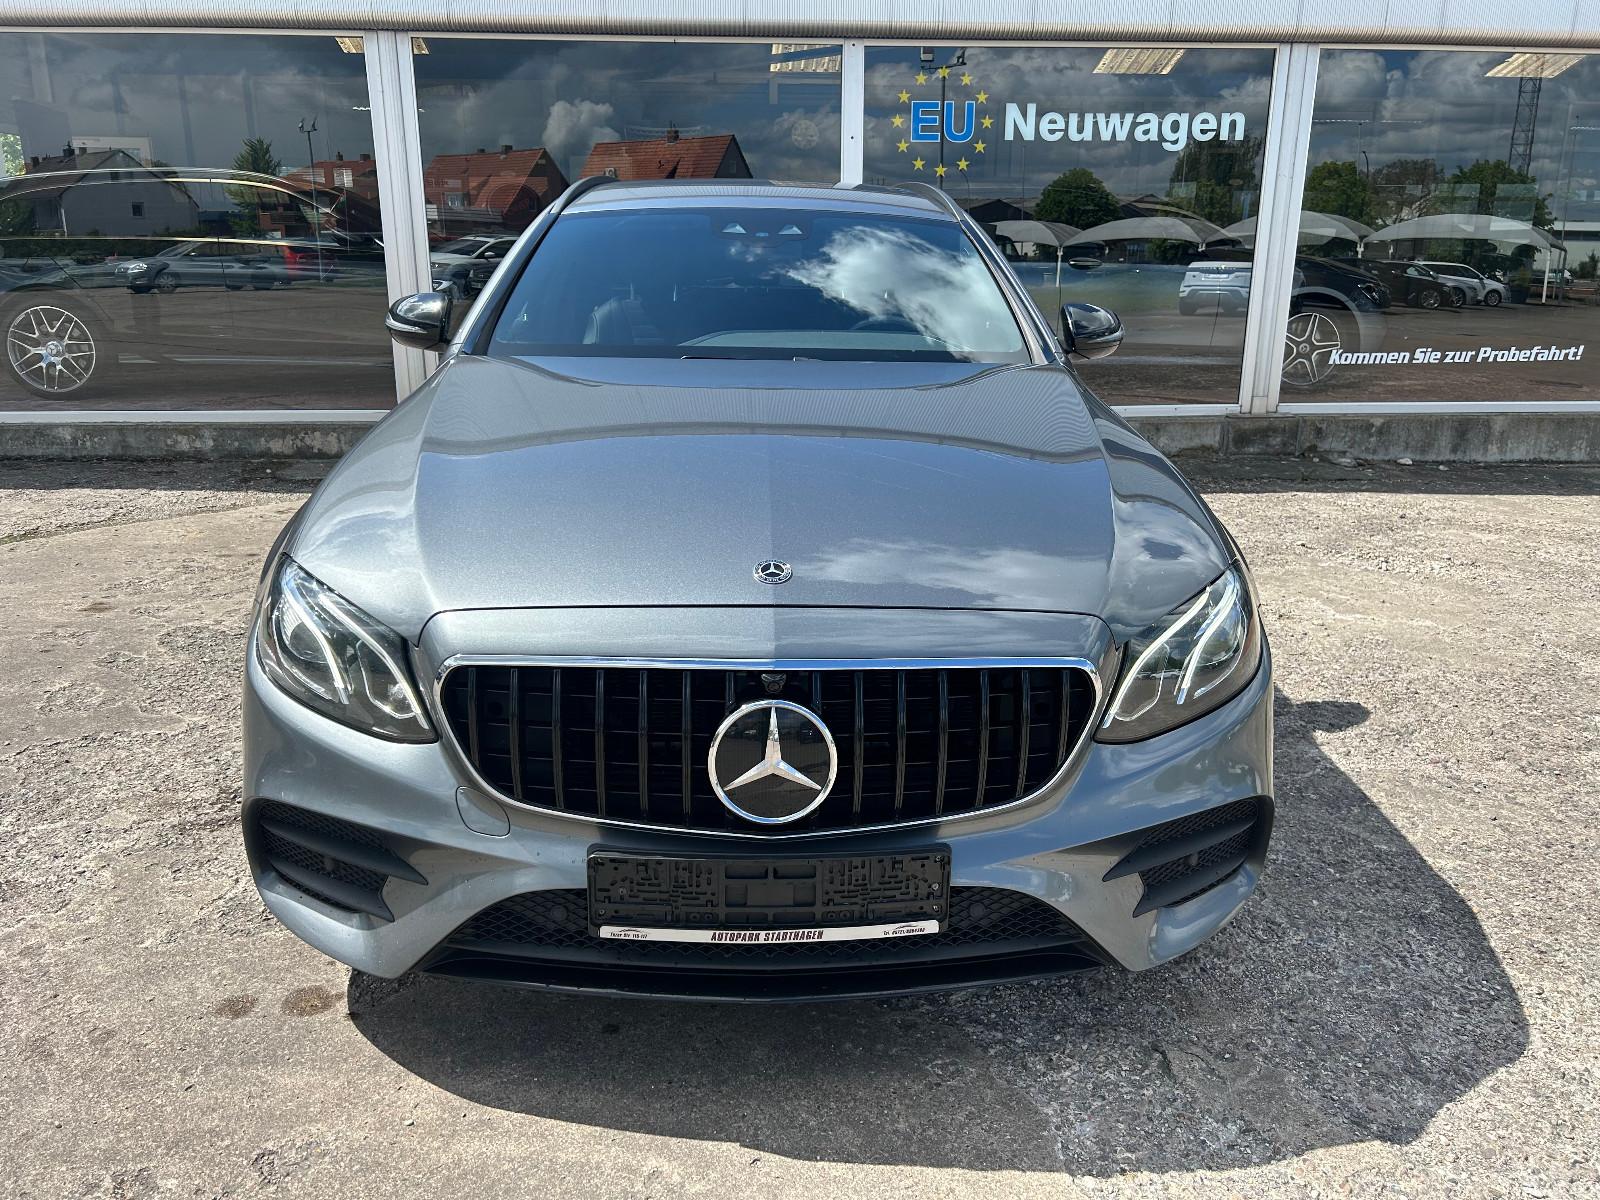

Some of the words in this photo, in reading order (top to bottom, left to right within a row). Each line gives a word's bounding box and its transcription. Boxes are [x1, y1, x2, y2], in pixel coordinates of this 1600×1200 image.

[911, 101, 975, 143] EU
[1004, 102, 1246, 152] Neuwagen
[1328, 349, 1409, 365] Kommen
[1412, 347, 1440, 364] Sie
[1443, 349, 1475, 364] zur
[1476, 345, 1584, 363] Probefahrt!
[711, 931, 760, 942] AUTOPARK
[763, 930, 824, 941] STADTHAGEN
